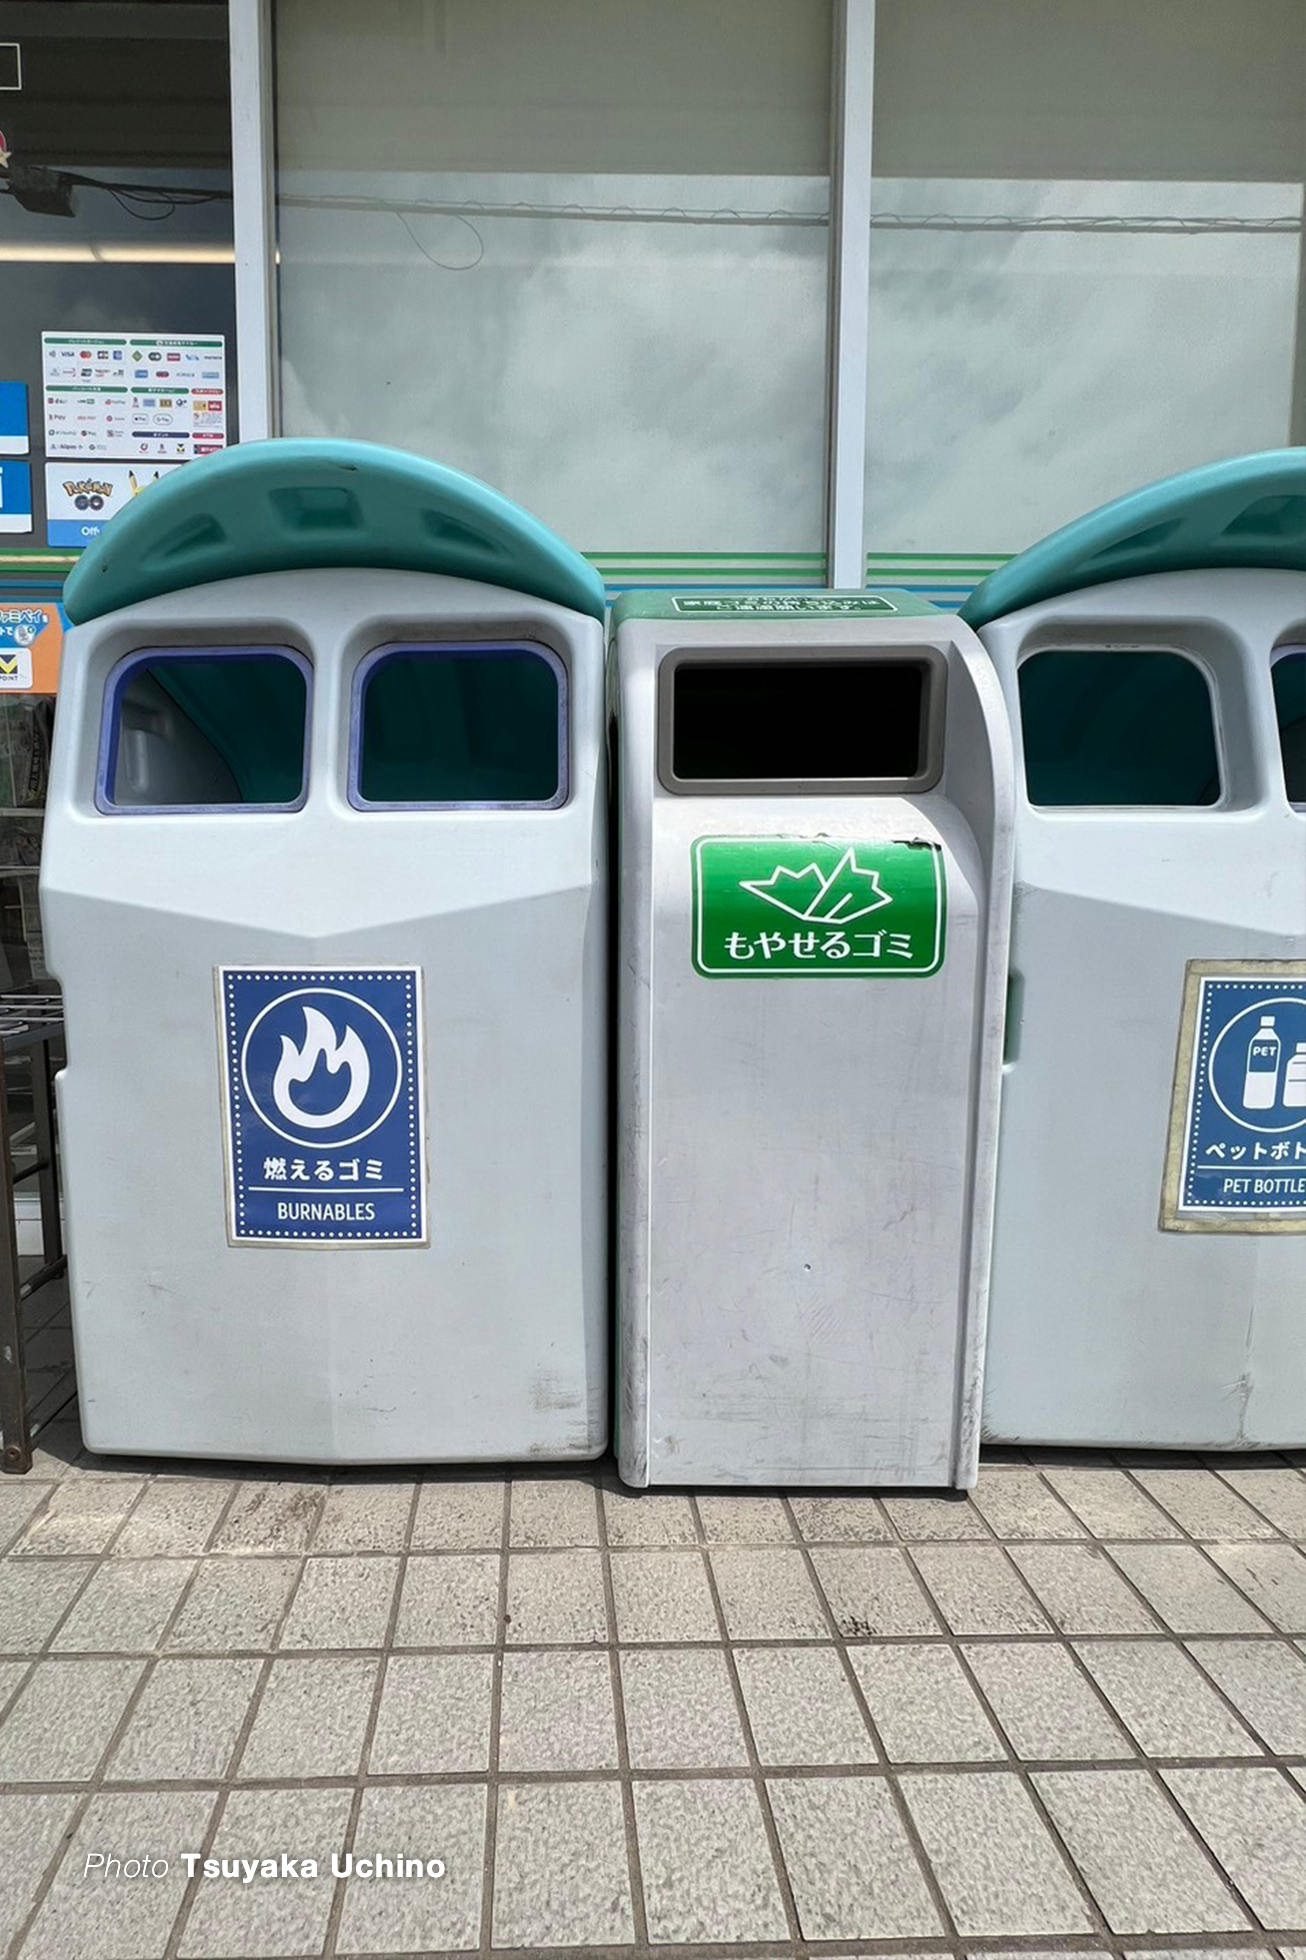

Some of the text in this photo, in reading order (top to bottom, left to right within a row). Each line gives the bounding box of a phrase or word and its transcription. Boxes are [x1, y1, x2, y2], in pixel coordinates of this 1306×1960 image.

[74, 494, 105, 511] GO
[724, 929, 914, 960] もやせるゴミ
[1253, 1046, 1277, 1057] PET
[263, 1157, 383, 1181] 燃えるゴミ
[1223, 1178, 1251, 1193] PET
[277, 1202, 375, 1220] BURNABLES
